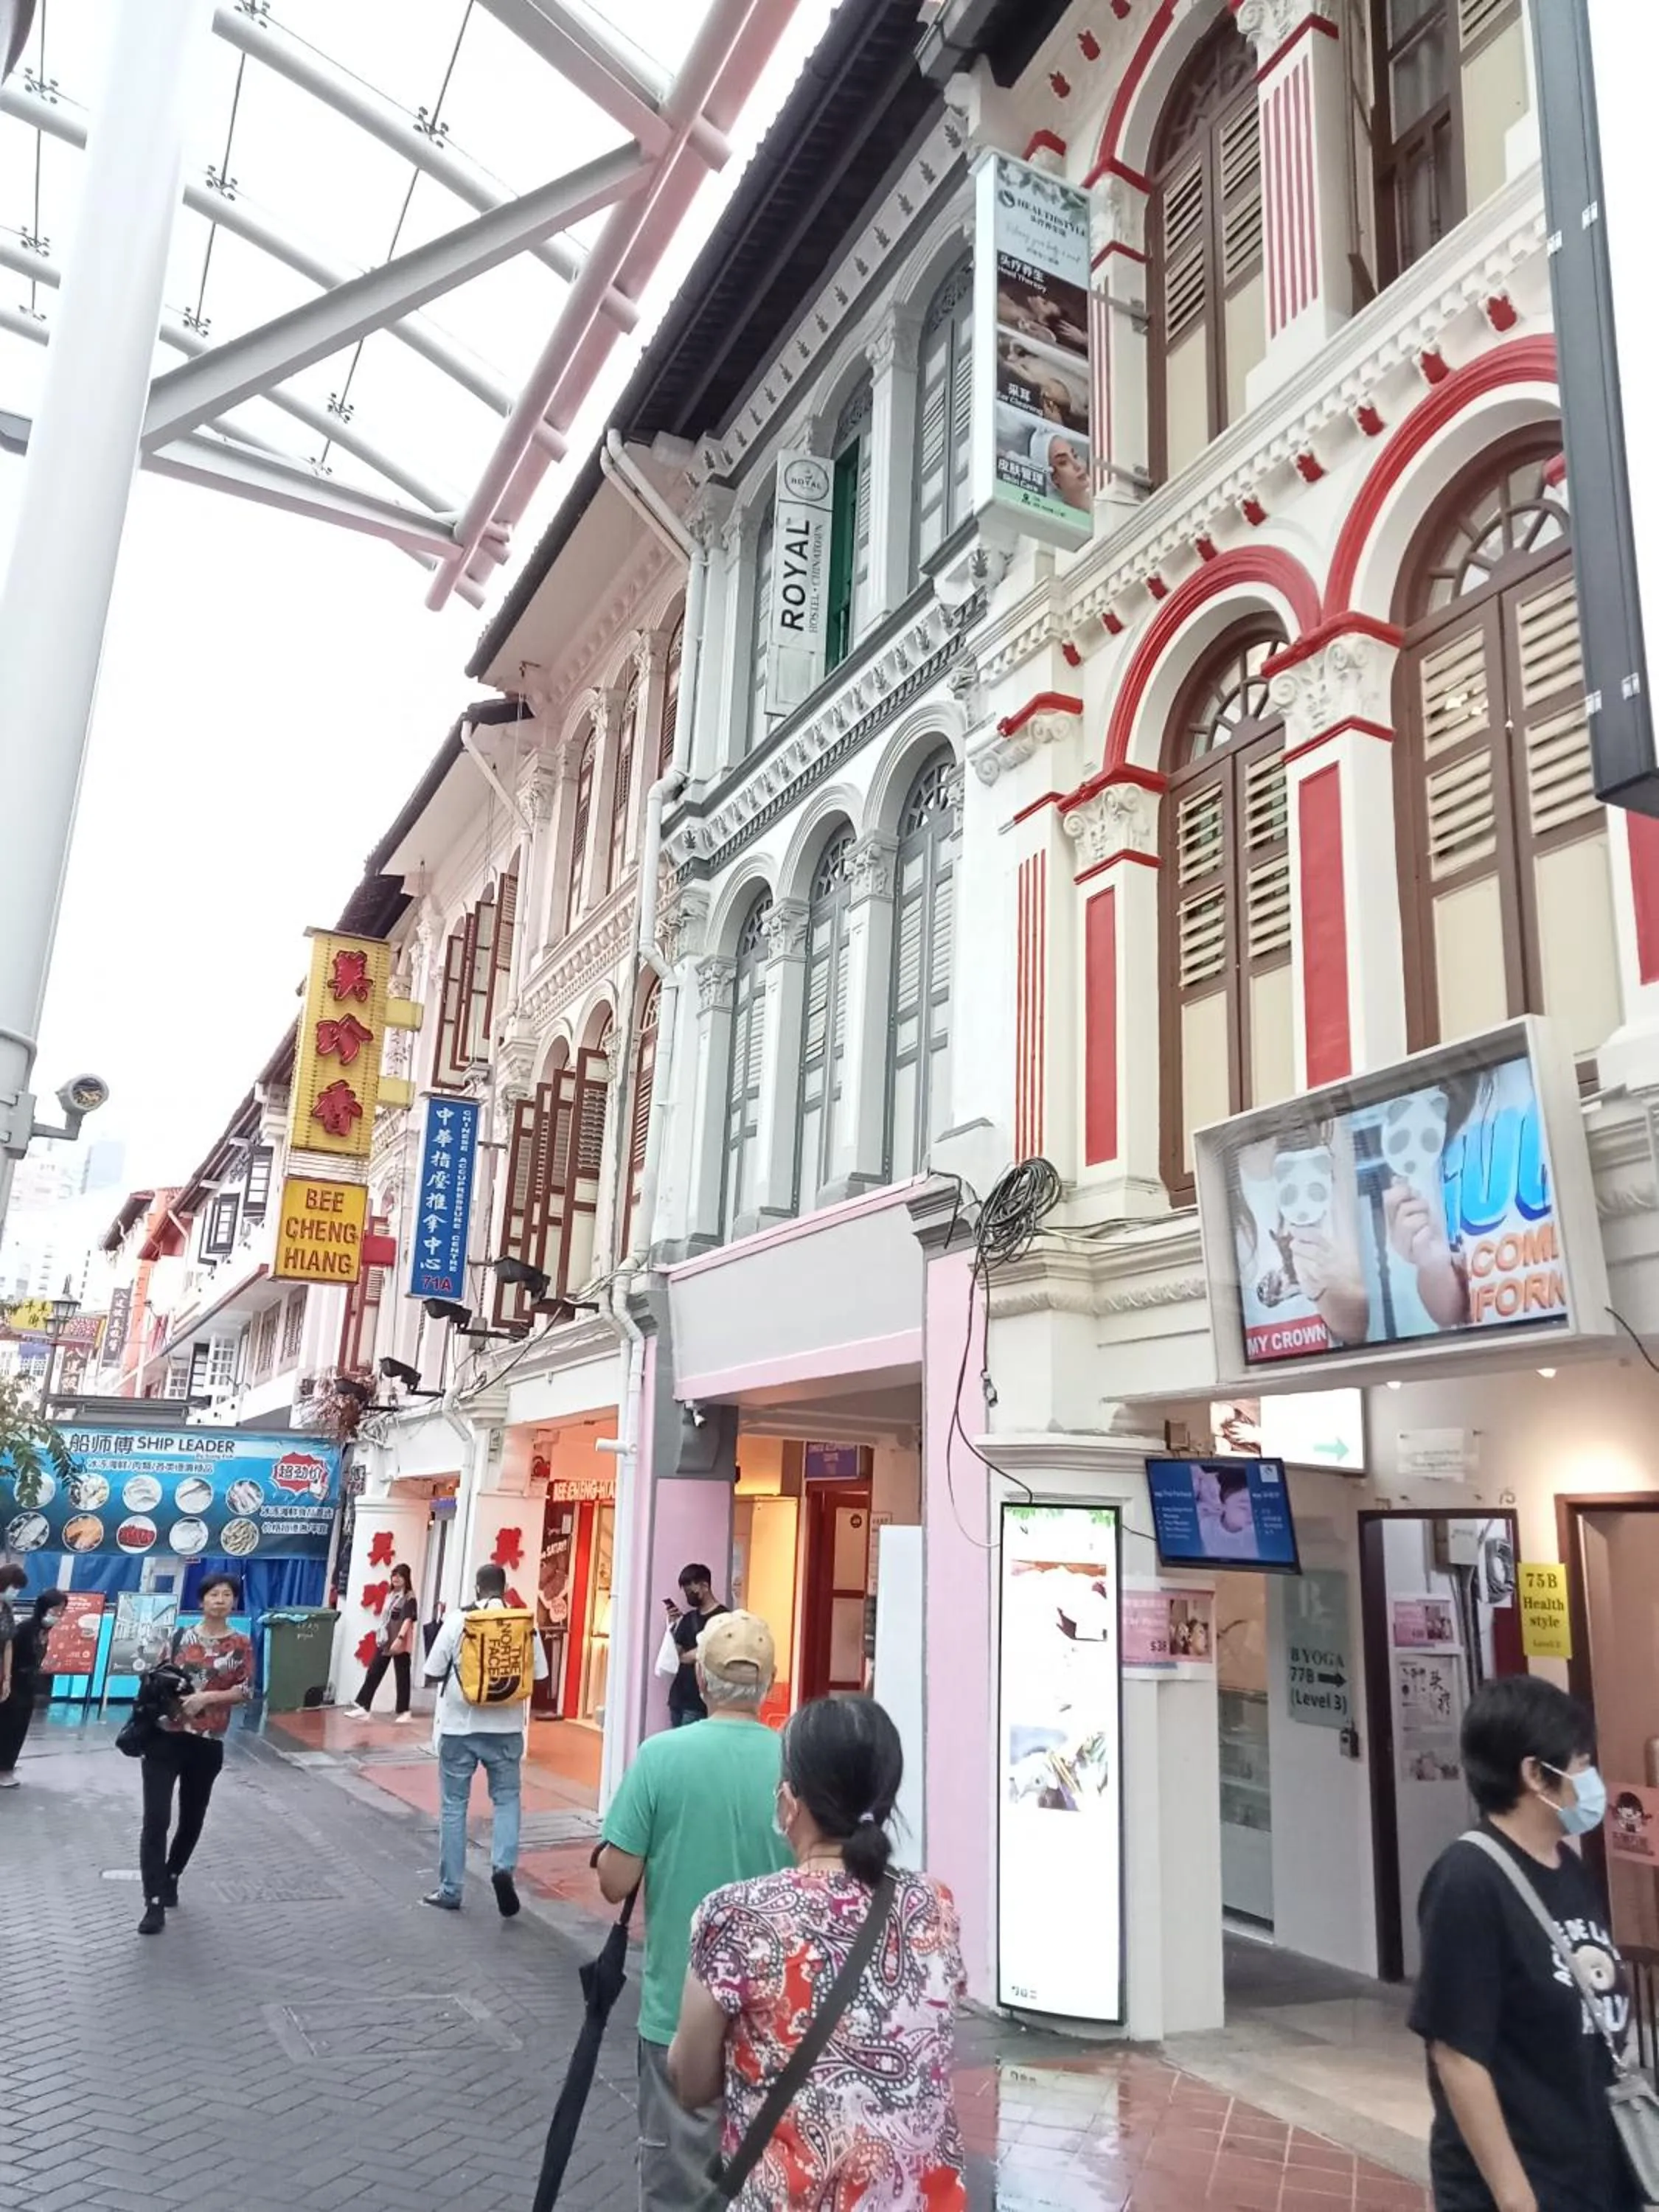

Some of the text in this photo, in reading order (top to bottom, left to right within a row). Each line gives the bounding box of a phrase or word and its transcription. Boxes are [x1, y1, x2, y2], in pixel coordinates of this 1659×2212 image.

[781, 519, 810, 631] ROYAL
[312, 950, 374, 1138] 美珍香
[460, 1110, 472, 1152] CHINESE
[306, 1188, 344, 1213] BEE
[285, 1216, 358, 1245] CHENG
[284, 1247, 354, 1274] HIANG
[449, 1235, 460, 1272] CENTRE
[422, 1275, 451, 1290] 71A
[1248, 1324, 1326, 1356] MY CROWN
[70, 1433, 133, 1455] 船师傅
[137, 1436, 235, 1453] SHIP LEADER
[1526, 1573, 1557, 1587] 75B
[1523, 1596, 1564, 1611] Health
[1530, 1615, 1560, 1630] style
[488, 1623, 521, 1675] THE NORTH FACE
[1290, 1666, 1315, 1683] 77B
[1290, 1687, 1348, 1716] (Level 3)
